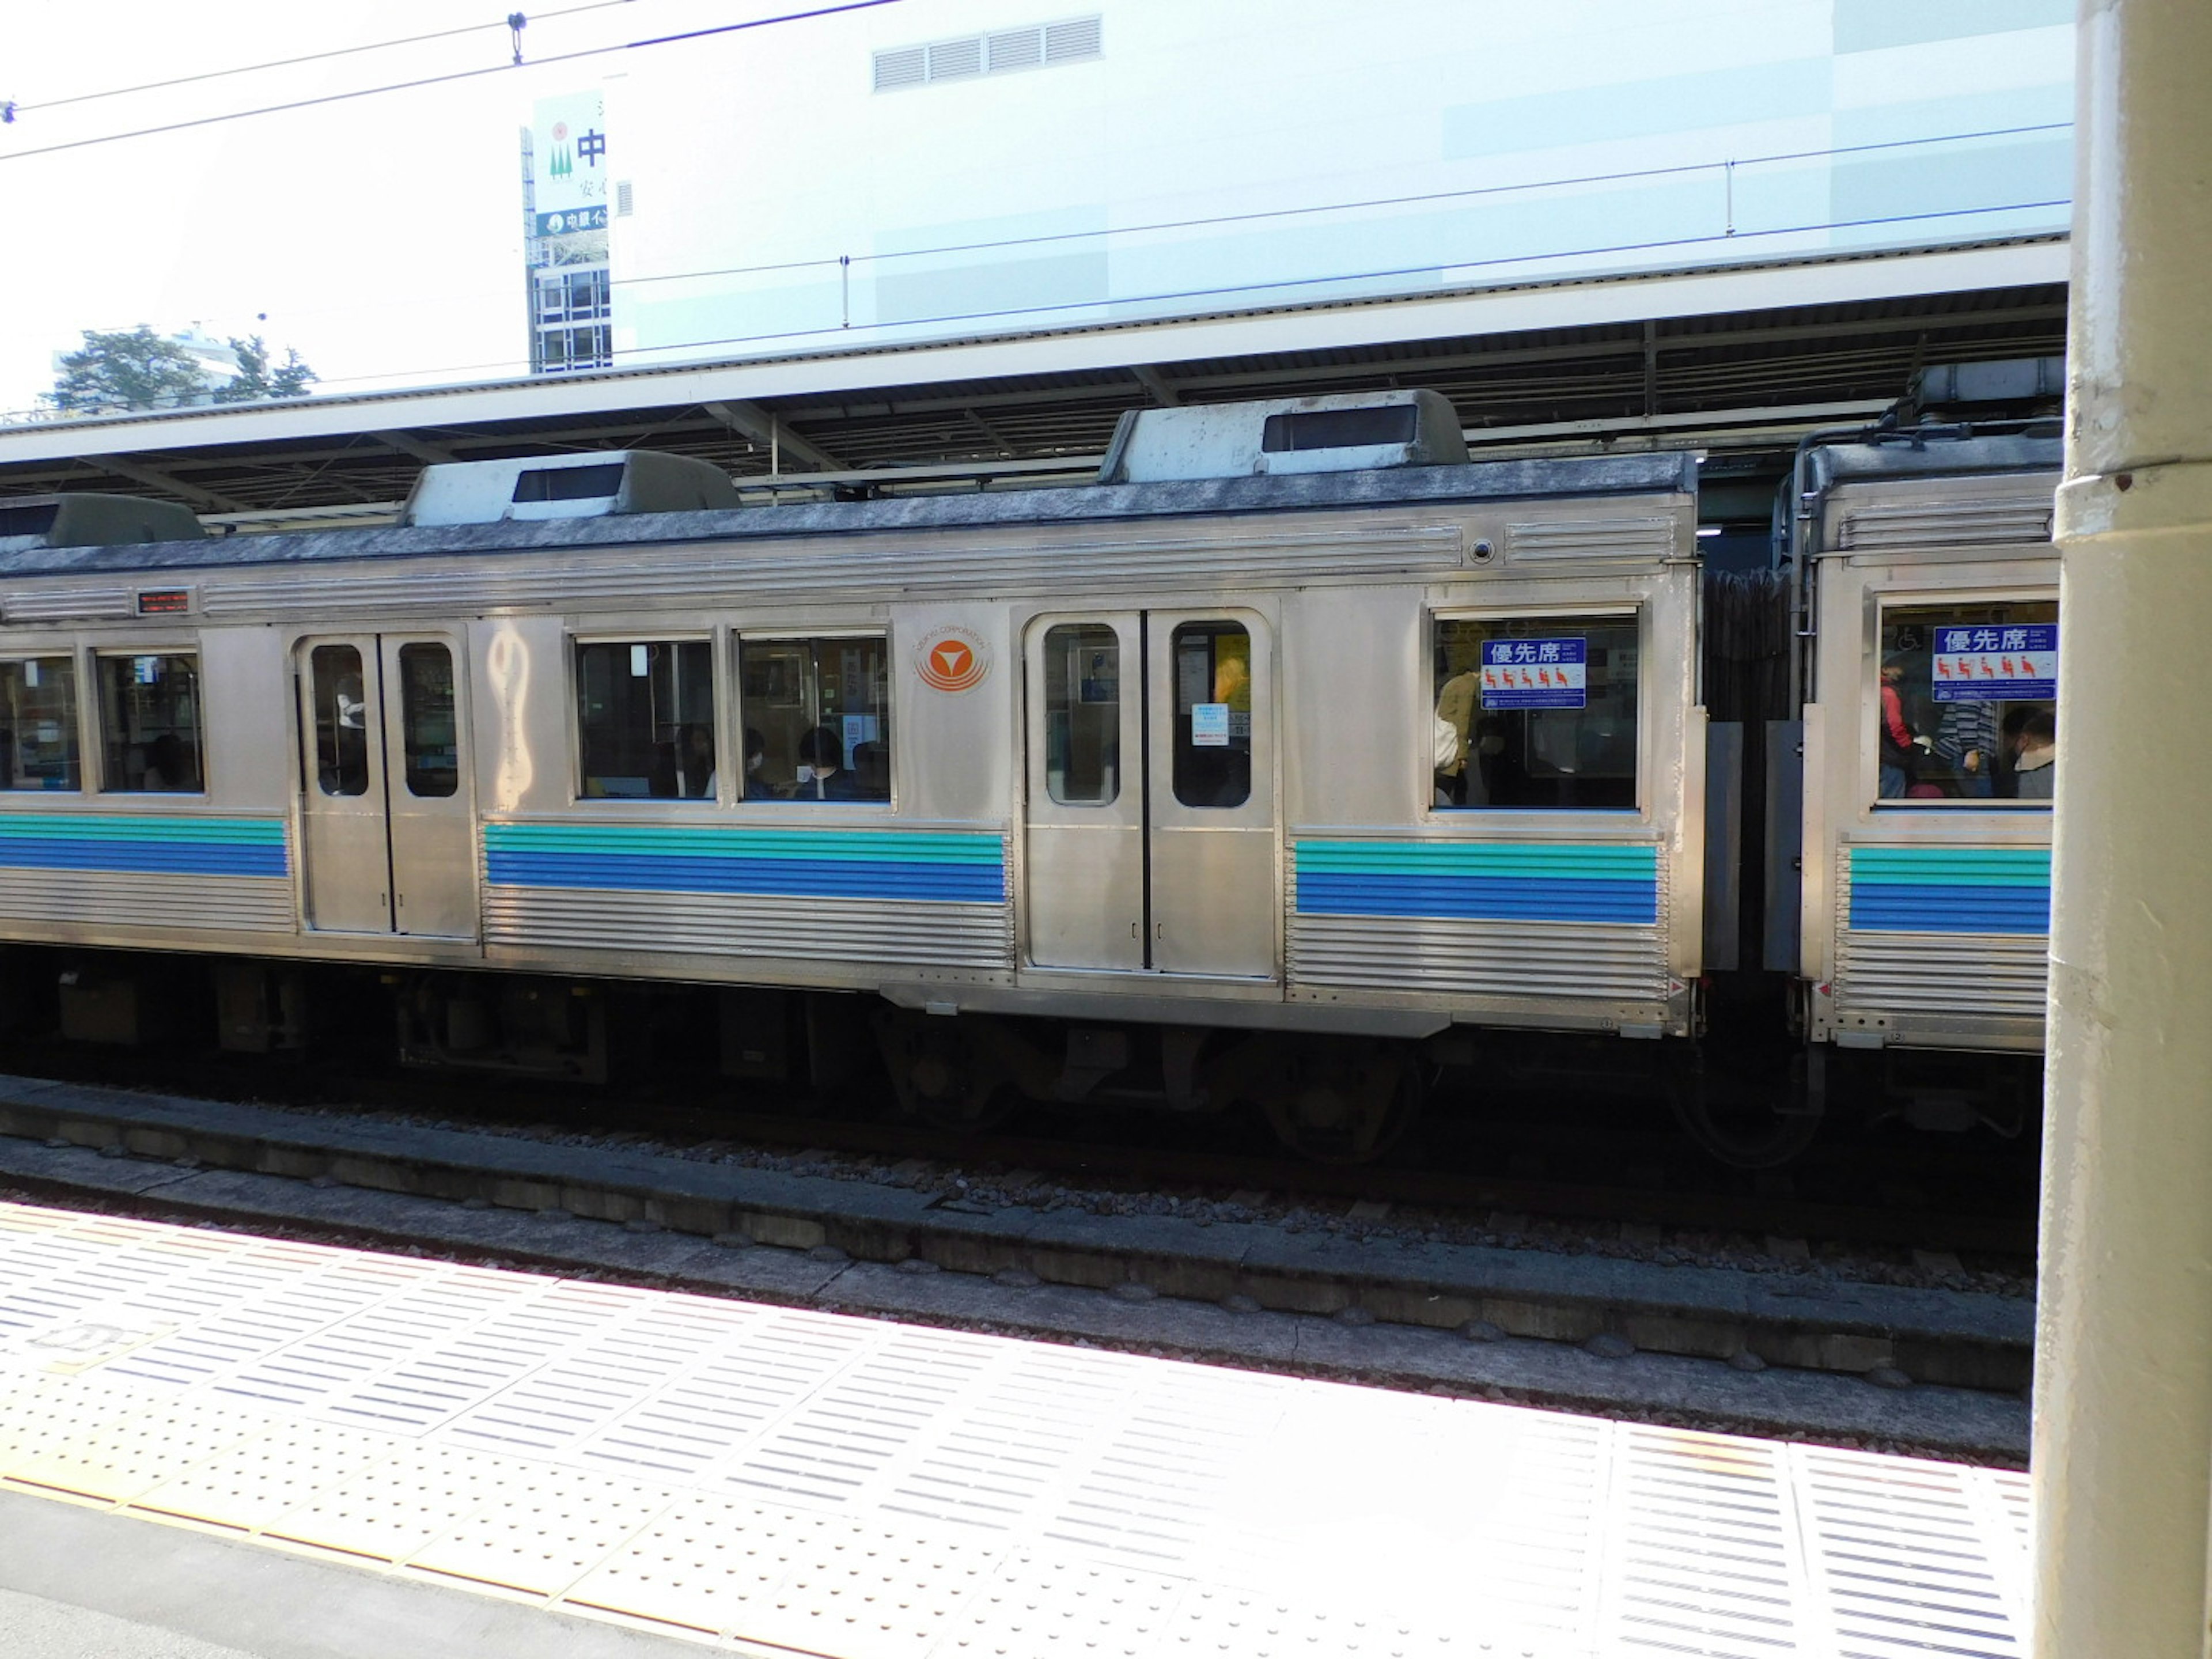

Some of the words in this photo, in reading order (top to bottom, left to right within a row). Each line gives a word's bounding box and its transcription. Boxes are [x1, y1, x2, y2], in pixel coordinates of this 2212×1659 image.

[578, 128, 605, 167] 中
[940, 626, 986, 650] CORPORATION
[1944, 630, 2028, 652] 優先席
[1491, 642, 1560, 664] 優先席
